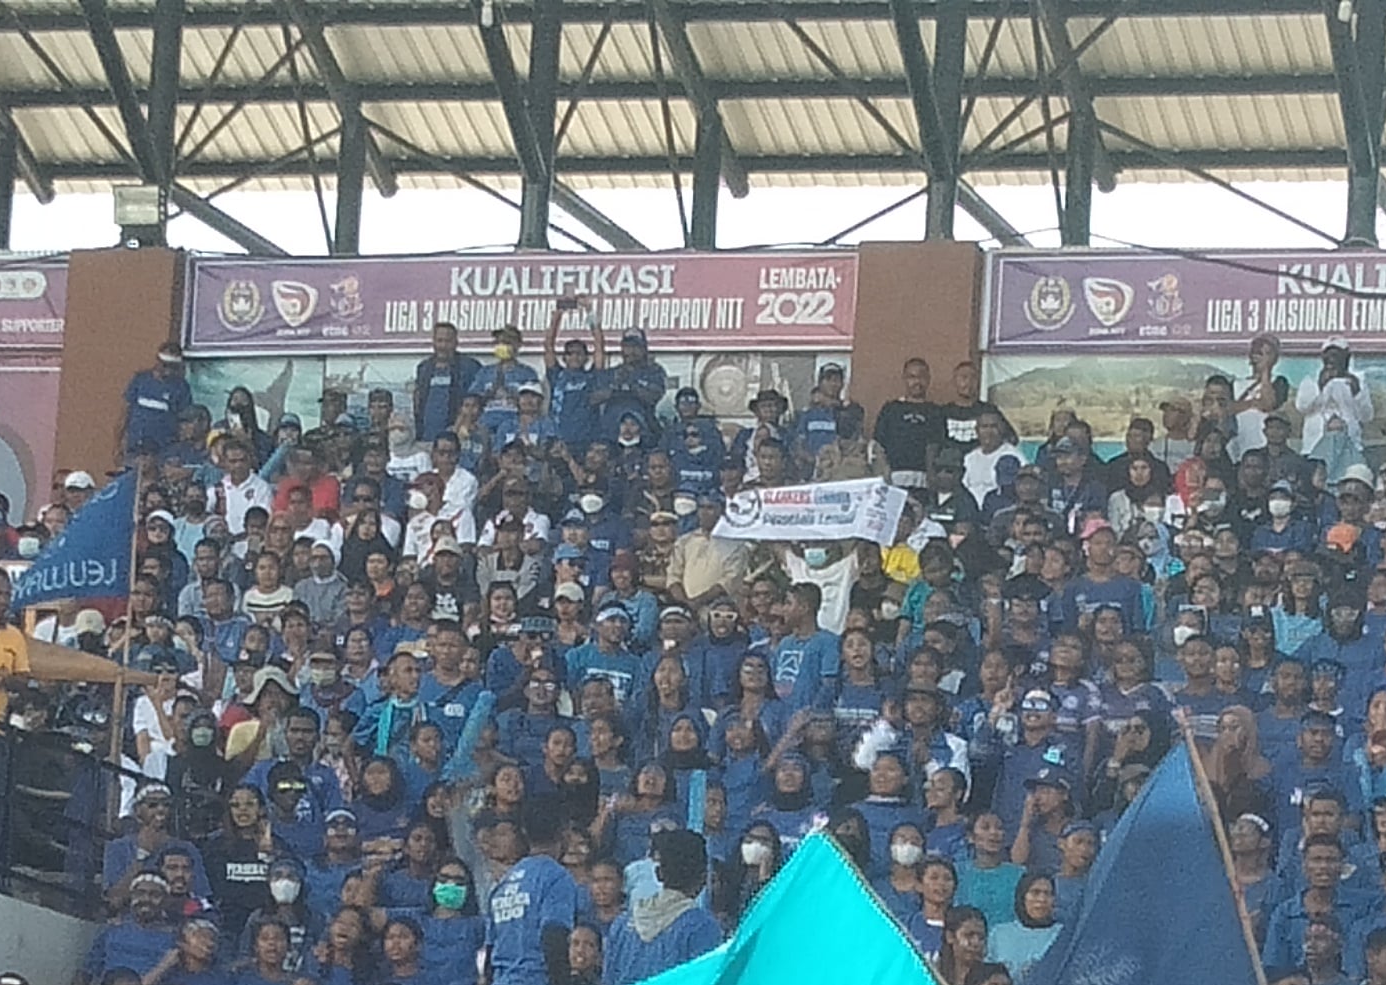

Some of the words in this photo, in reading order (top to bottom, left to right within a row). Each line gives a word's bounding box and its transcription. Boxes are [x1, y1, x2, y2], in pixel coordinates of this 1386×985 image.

[450, 263, 675, 296] KUALIFIKASI
[384, 300, 418, 332] LIGA
[422, 300, 434, 332] 3
[437, 300, 513, 332] NASIONAL
[601, 300, 634, 332] DAN
[638, 300, 713, 332] PORPROV
[716, 300, 745, 332] NTT
[755, 291, 835, 325] 2022
[1206, 298, 1243, 332] LIGA
[1248, 298, 1260, 332] 3
[1264, 298, 1347, 332] NASIONAL
